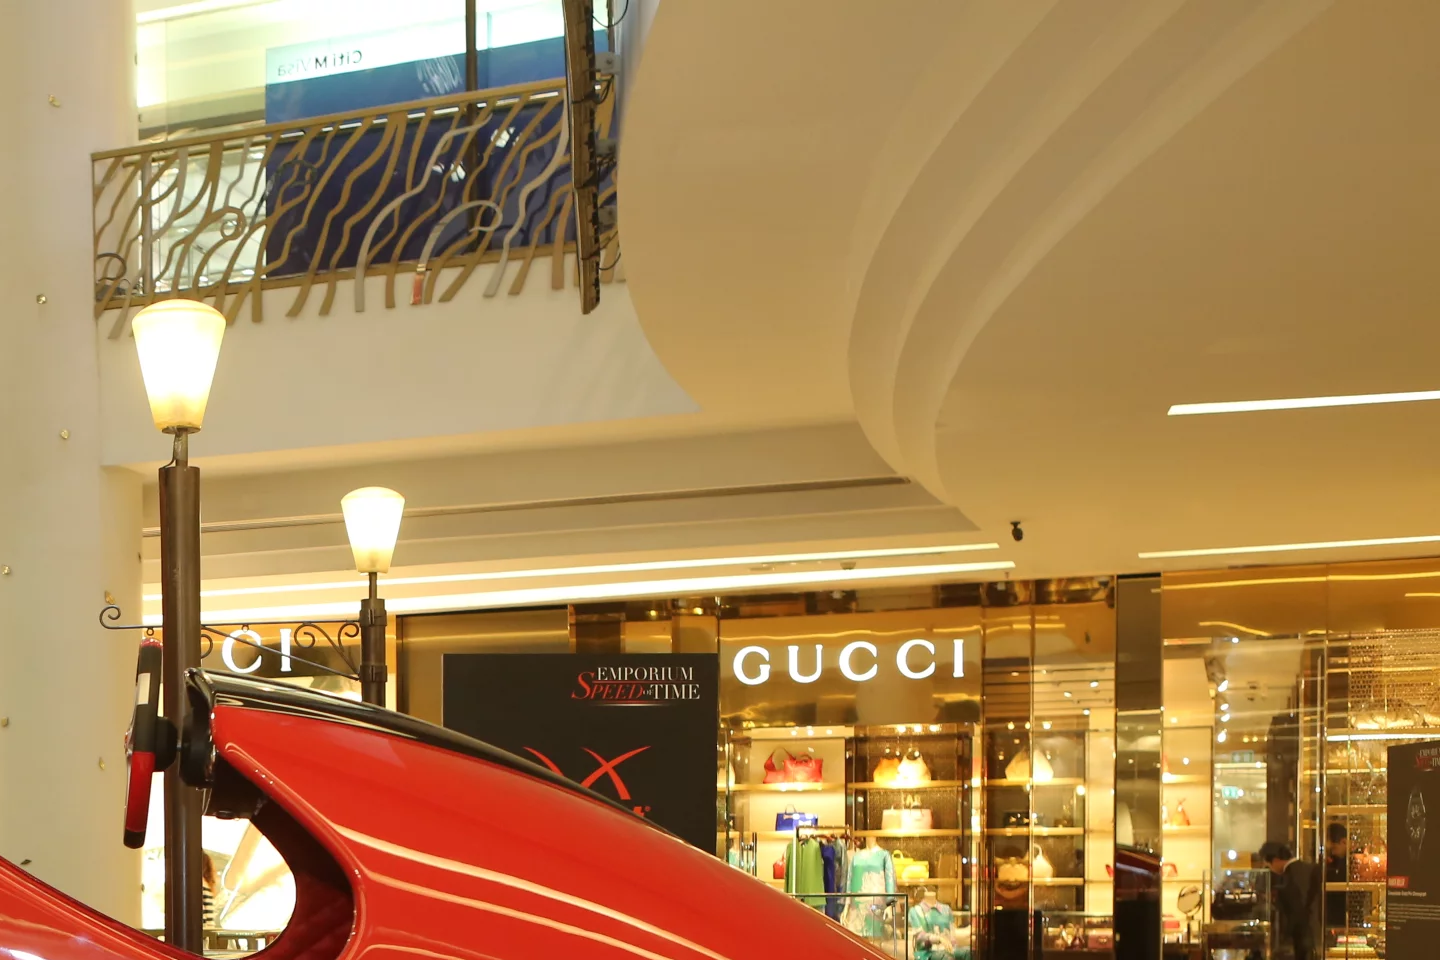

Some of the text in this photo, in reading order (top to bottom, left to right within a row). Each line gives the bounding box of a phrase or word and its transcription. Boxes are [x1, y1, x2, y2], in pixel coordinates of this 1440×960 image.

[732, 638, 965, 686] GUCCI
[597, 666, 694, 681] EMPORIUM
[650, 683, 701, 700] TIME
